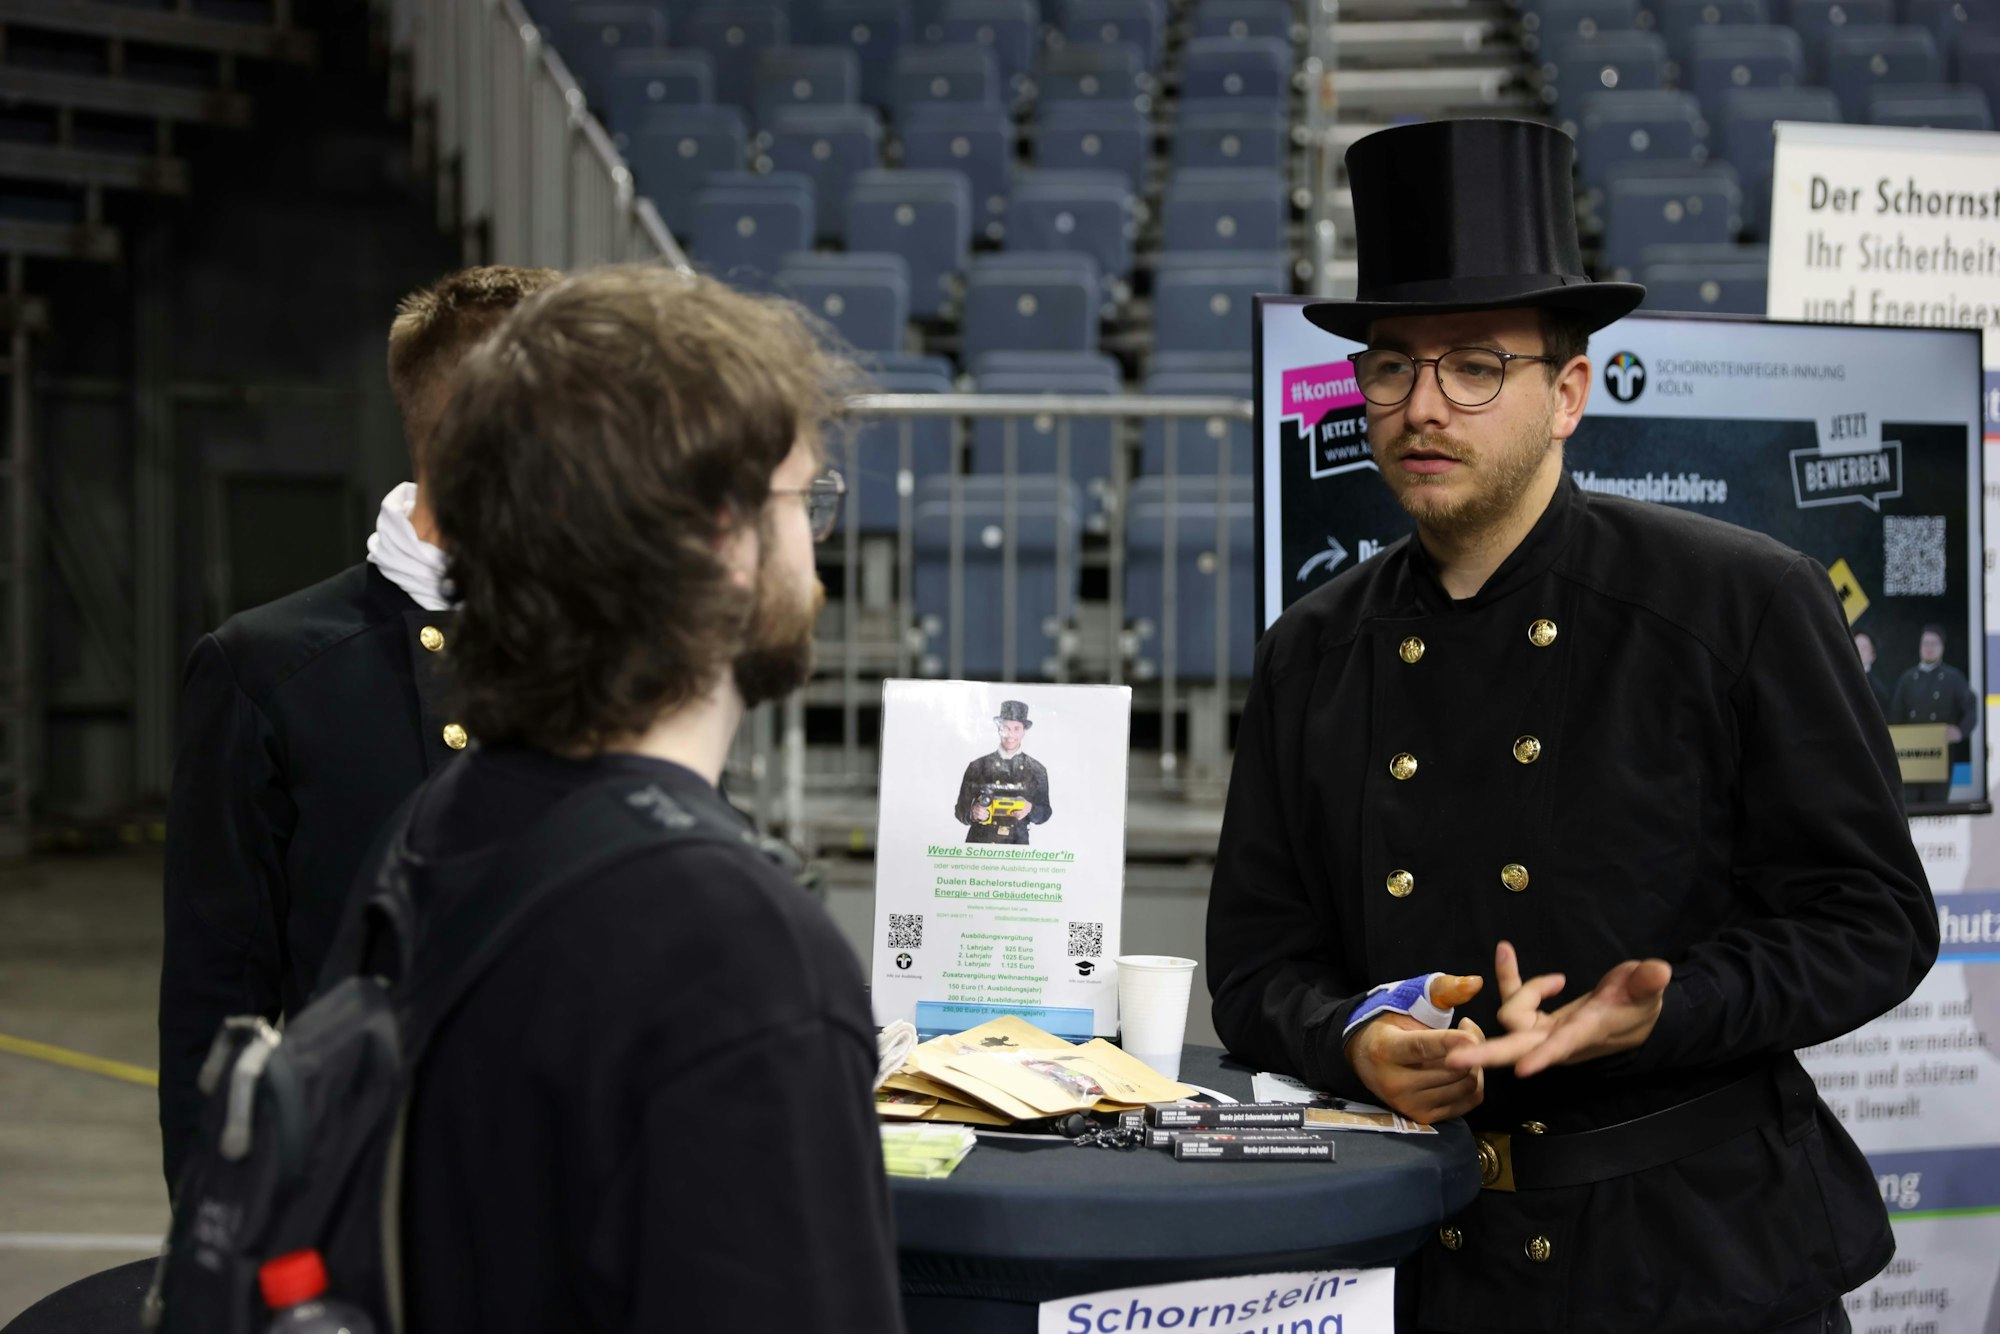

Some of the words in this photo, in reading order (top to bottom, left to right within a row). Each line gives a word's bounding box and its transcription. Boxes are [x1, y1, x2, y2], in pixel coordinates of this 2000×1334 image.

[1811, 176, 1859, 212] Der
[1806, 231, 1843, 268] Ihr
[1859, 232, 2000, 276] Sicherheit
[1656, 379, 1694, 395] KÖLN
[1321, 418, 1356, 443] JETZT
[1829, 411, 1868, 441] JETZT
[1804, 452, 1892, 493] BEWERBEN
[928, 846, 962, 857] Werde
[951, 863, 979, 871] verbinde
[1000, 865, 1038, 874] Ausbildung
[936, 877, 967, 885] Dualen
[969, 878, 1062, 891] Bachelorstudiengang
[935, 888, 971, 898] Energie-
[973, 889, 990, 898] und
[992, 890, 1063, 901] Gebäudetechnik
[961, 932, 1033, 942] Ausbildungsvergütung
[965, 961, 991, 969] Lehrjahr
[997, 974, 1048, 982] Weihnachtsgeld
[987, 985, 1042, 993] Ausbildungsjahr)
[987, 997, 1042, 1005] Ausbildungsjahr)
[1220, 1113, 1233, 1121] Werde
[1066, 1276, 1358, 1334] Schornstein-
